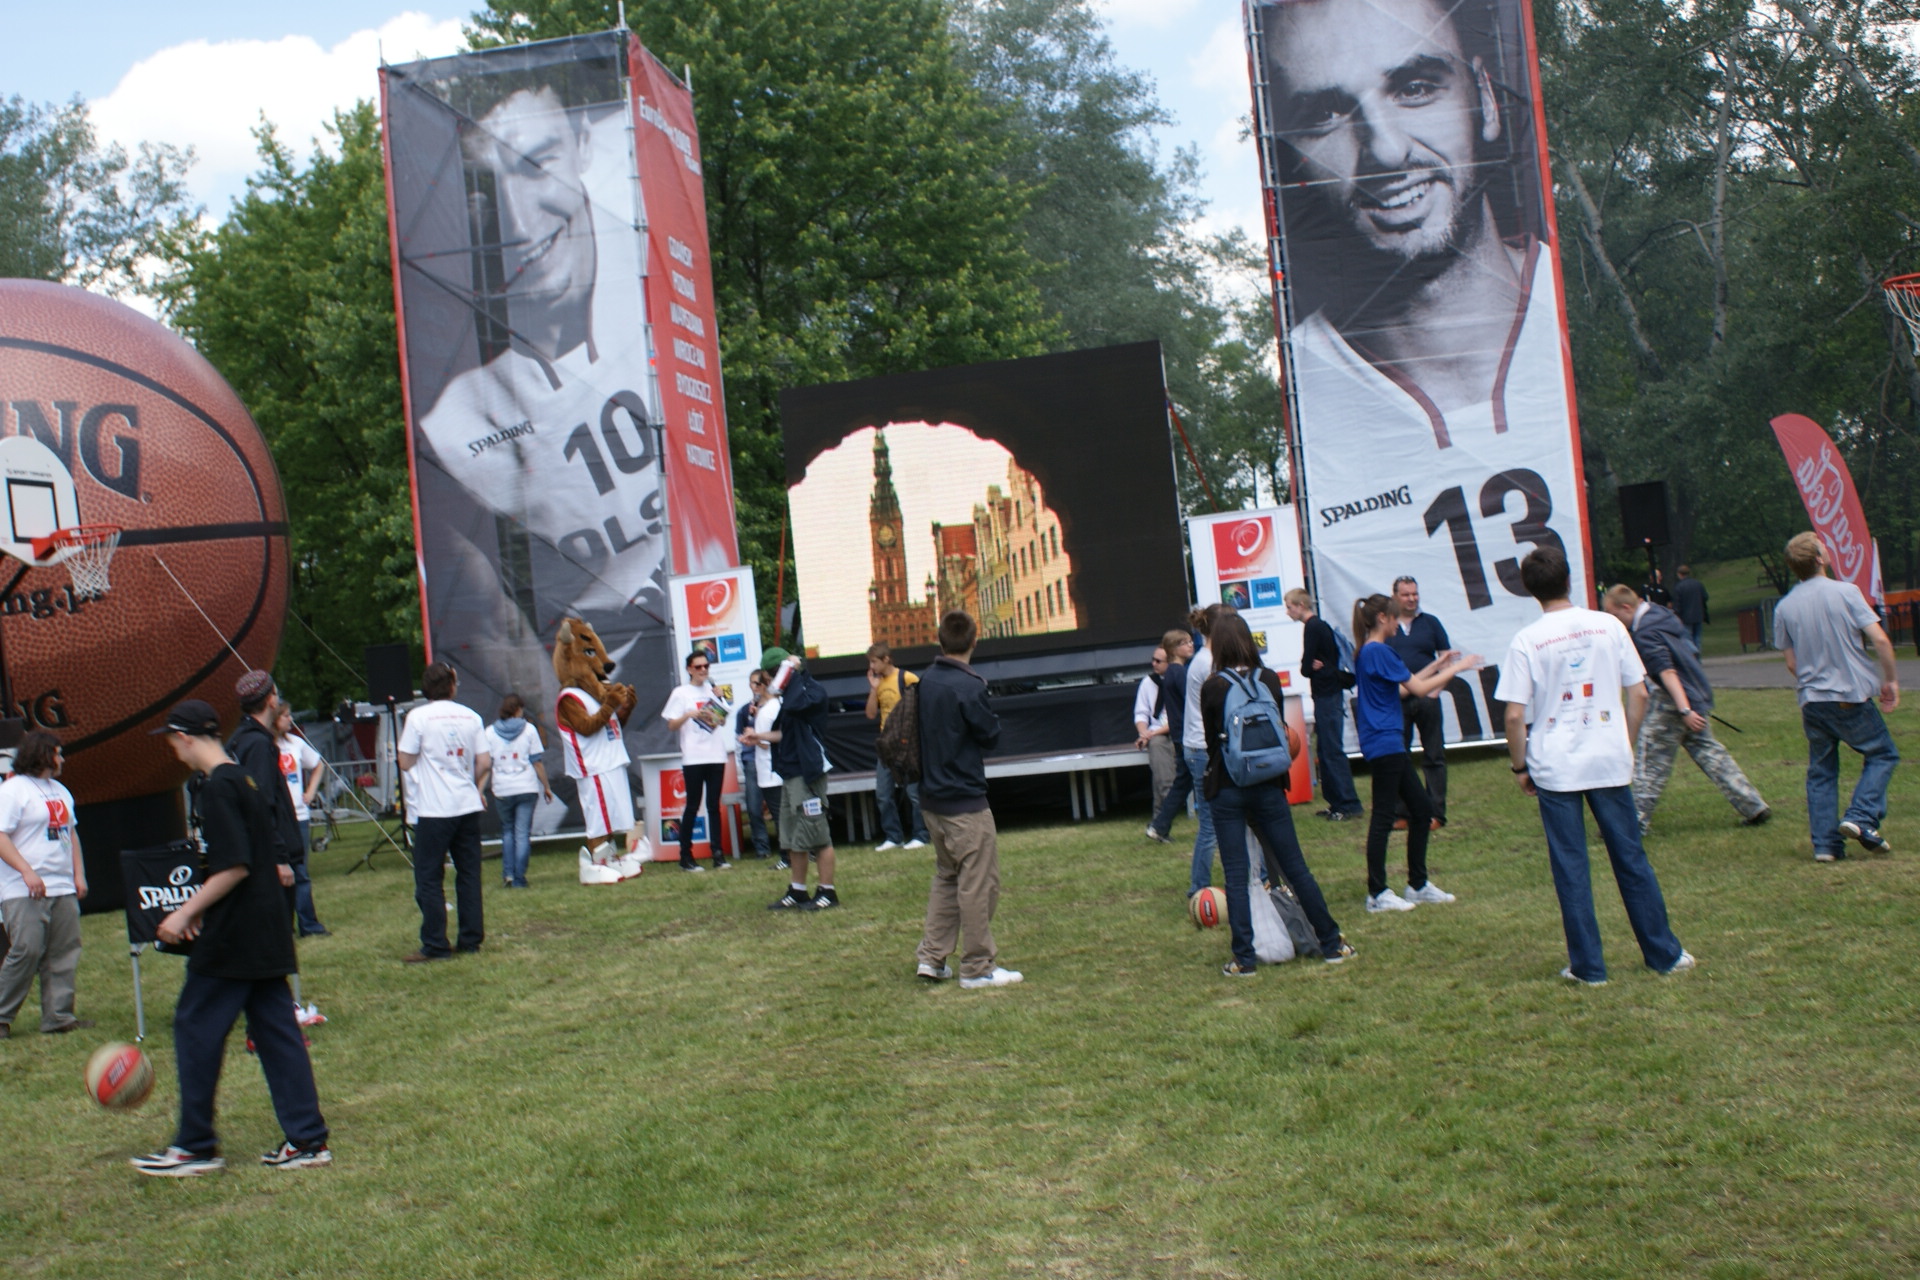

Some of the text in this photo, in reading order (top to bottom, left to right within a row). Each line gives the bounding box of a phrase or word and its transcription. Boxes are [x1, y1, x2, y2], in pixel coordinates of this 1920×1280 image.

[468, 420, 535, 458] SPALDING
[563, 390, 656, 496] 10
[1320, 484, 1413, 527] SPALDING
[1423, 467, 1568, 610] 13
